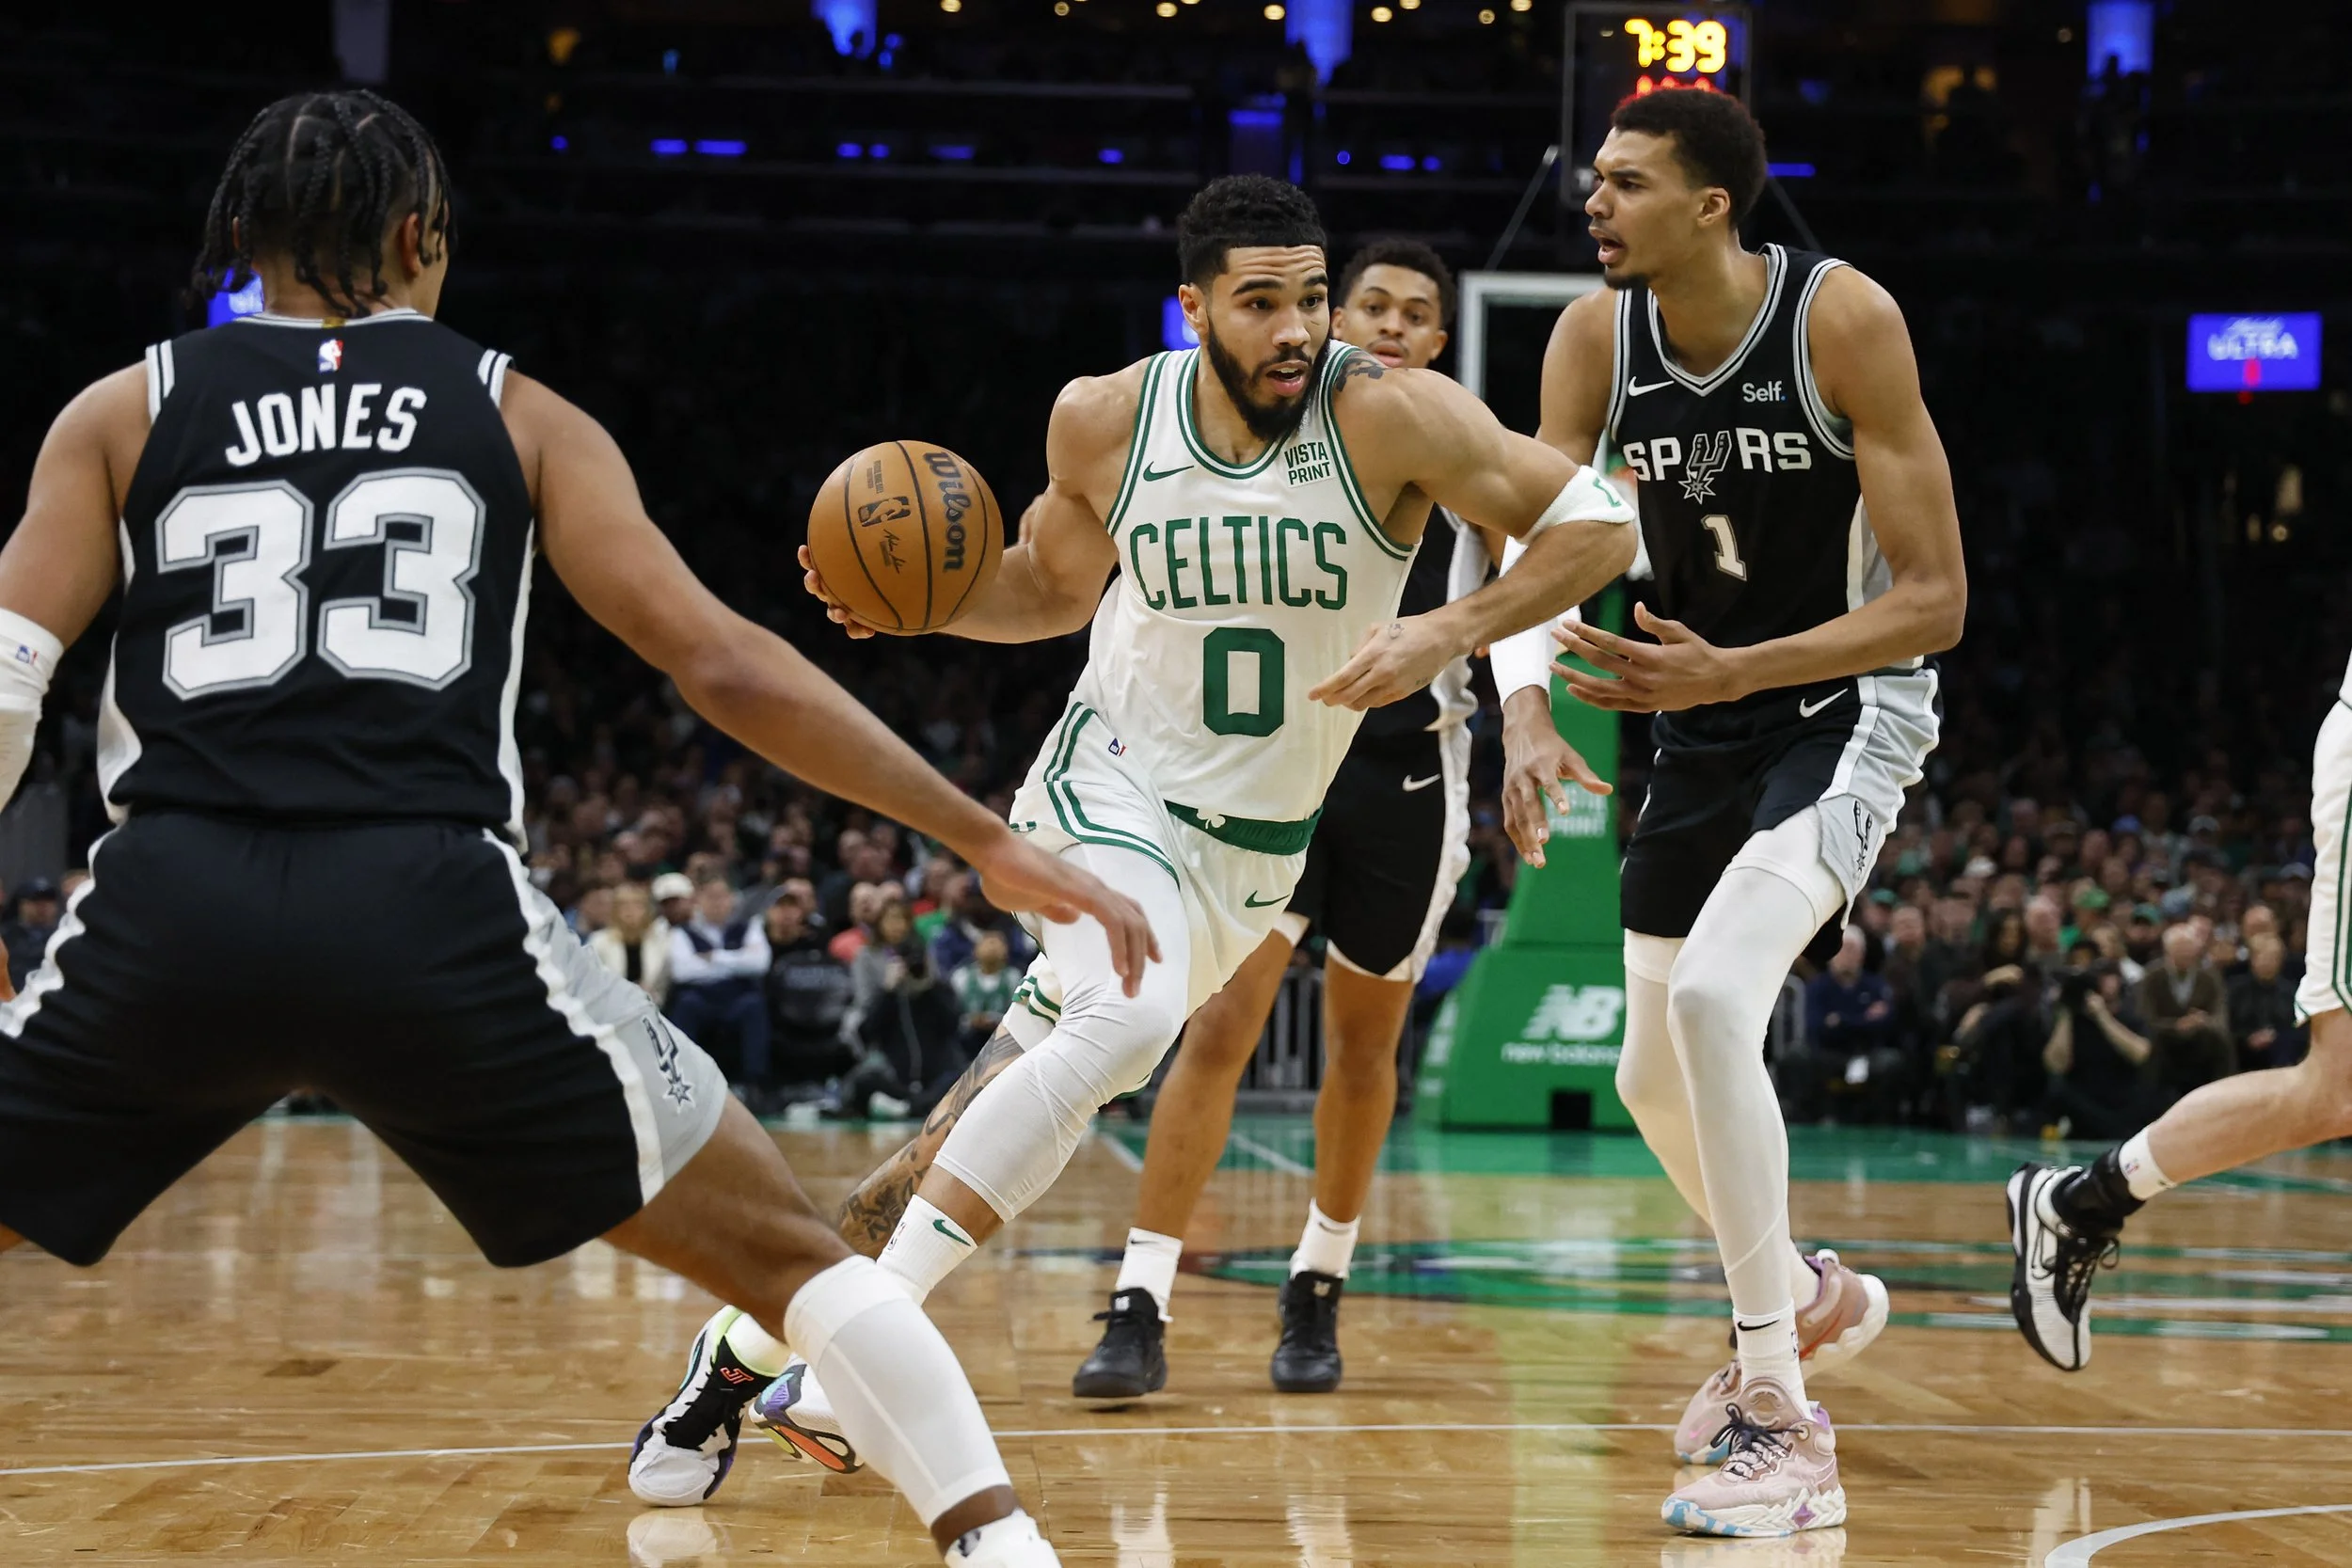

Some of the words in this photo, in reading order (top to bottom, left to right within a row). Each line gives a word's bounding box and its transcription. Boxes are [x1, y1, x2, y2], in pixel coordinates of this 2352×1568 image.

[1624, 18, 1726, 73] 7:39
[225, 383, 427, 467] JONES
[1284, 442, 1328, 468] VISTA
[1623, 427, 1812, 499] SPURS
[922, 451, 972, 573] Wilson
[1288, 462, 1330, 485] PRINT
[154, 467, 486, 702] 33
[1130, 515, 1347, 610] CELTICS
[1700, 515, 1747, 581] 1
[1203, 626, 1285, 737] 0
